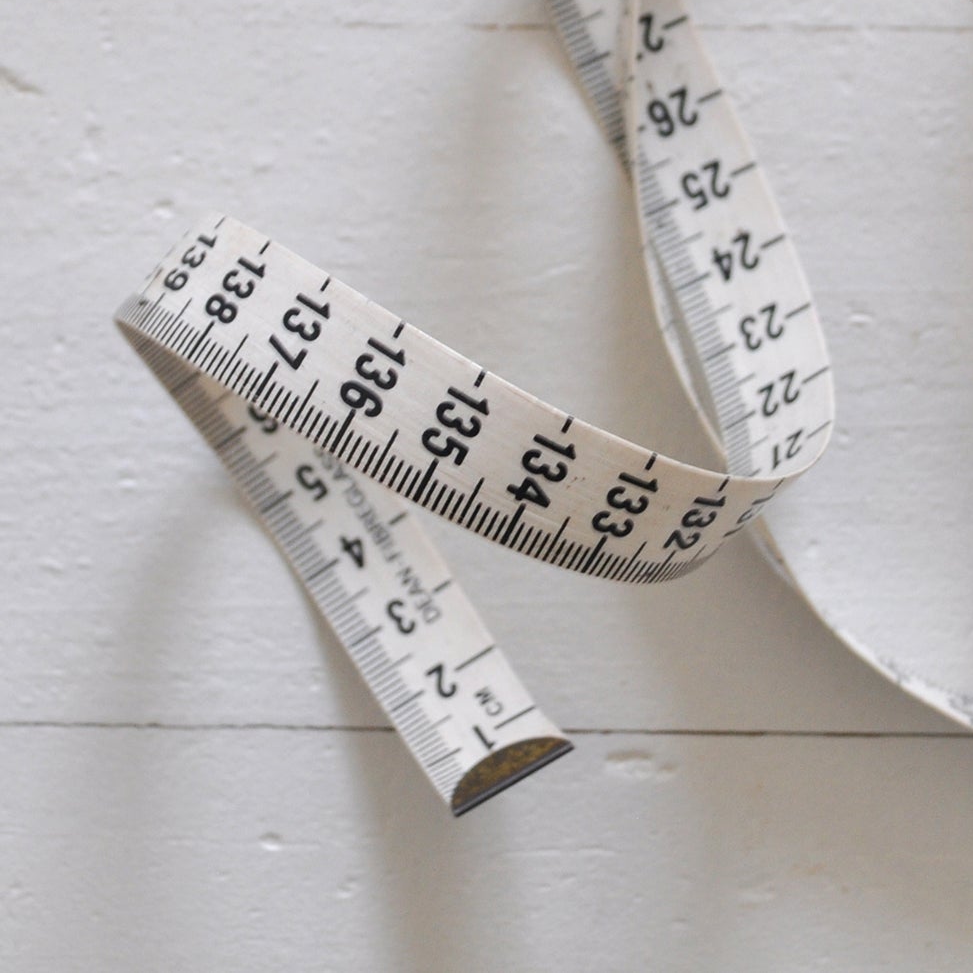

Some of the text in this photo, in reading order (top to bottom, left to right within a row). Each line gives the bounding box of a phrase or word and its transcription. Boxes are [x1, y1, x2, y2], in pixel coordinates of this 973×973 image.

[636, 13, 664, 61] 2
[647, 87, 698, 137] 26
[681, 161, 730, 210] 25
[163, 233, 218, 291] 139
[713, 232, 760, 282] 24
[205, 256, 266, 324] 138
[269, 292, 331, 370] 137
[739, 303, 784, 351] 23
[340, 337, 406, 417] 136
[757, 370, 800, 418] 22
[421, 386, 490, 466] 135
[771, 428, 804, 471] 21
[296, 464, 327, 501] 5
[507, 433, 577, 508] 134
[592, 472, 658, 538] 133
[663, 495, 726, 550] 132
[340, 535, 364, 568] 4
[387, 599, 416, 633] 3
[425, 664, 458, 698] 2
[474, 685, 505, 717] CM
[473, 724, 496, 751] 1
